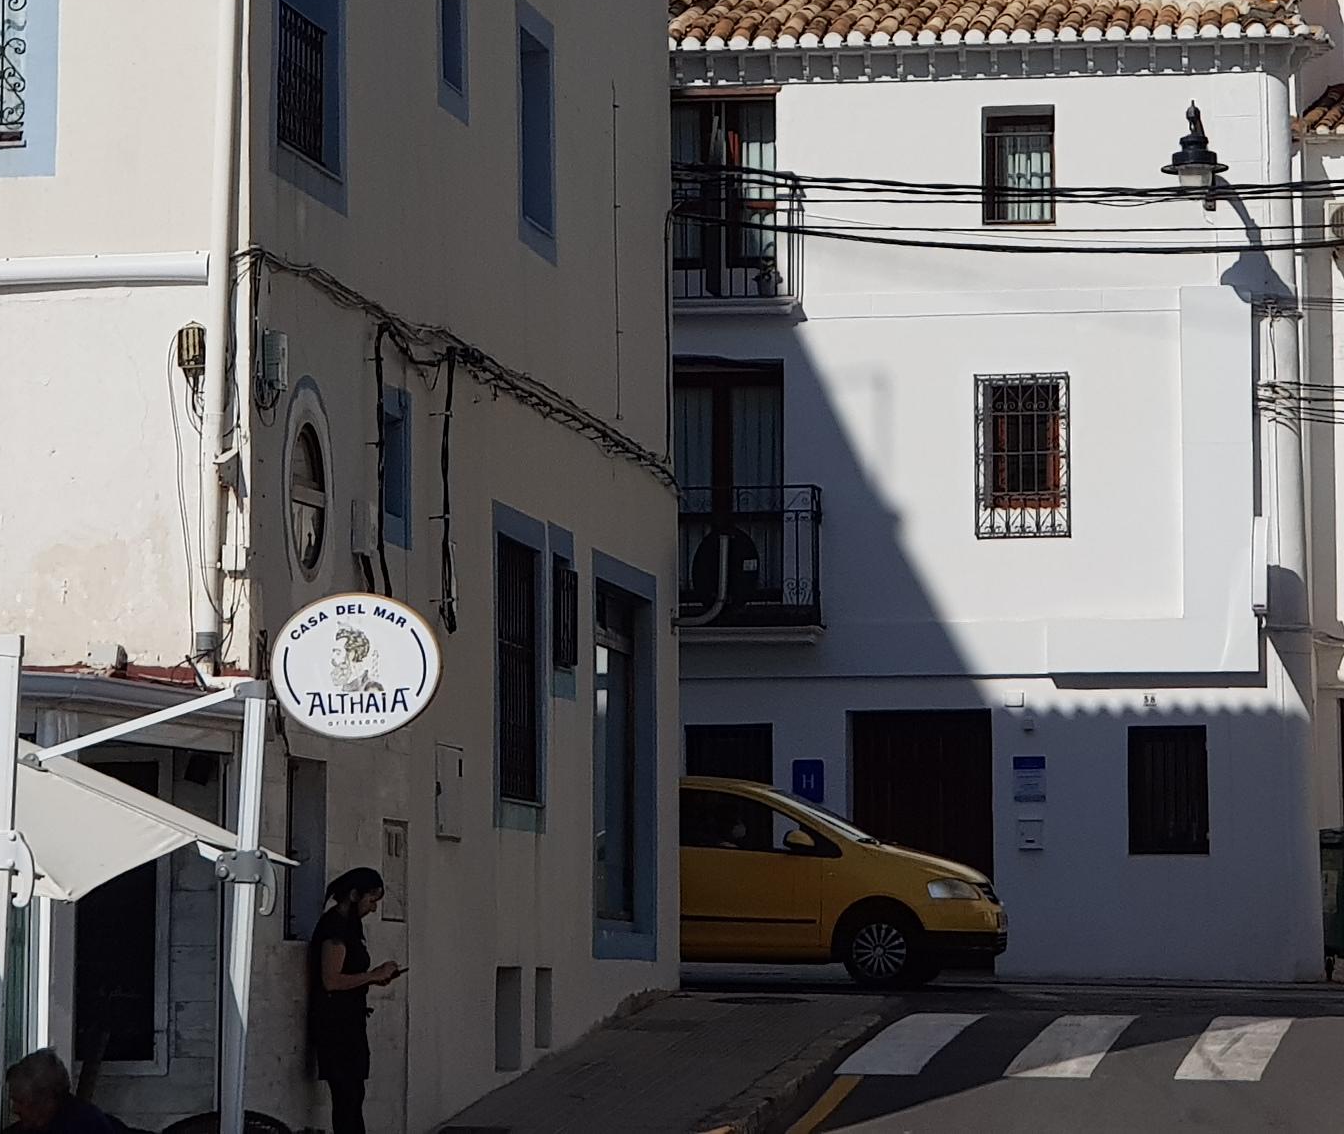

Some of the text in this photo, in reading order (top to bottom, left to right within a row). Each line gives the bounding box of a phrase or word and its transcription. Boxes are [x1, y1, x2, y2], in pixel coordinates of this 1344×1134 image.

[290, 604, 407, 640] CASA DEL MAR
[327, 718, 386, 728] artesano
[802, 774, 814, 789] H
